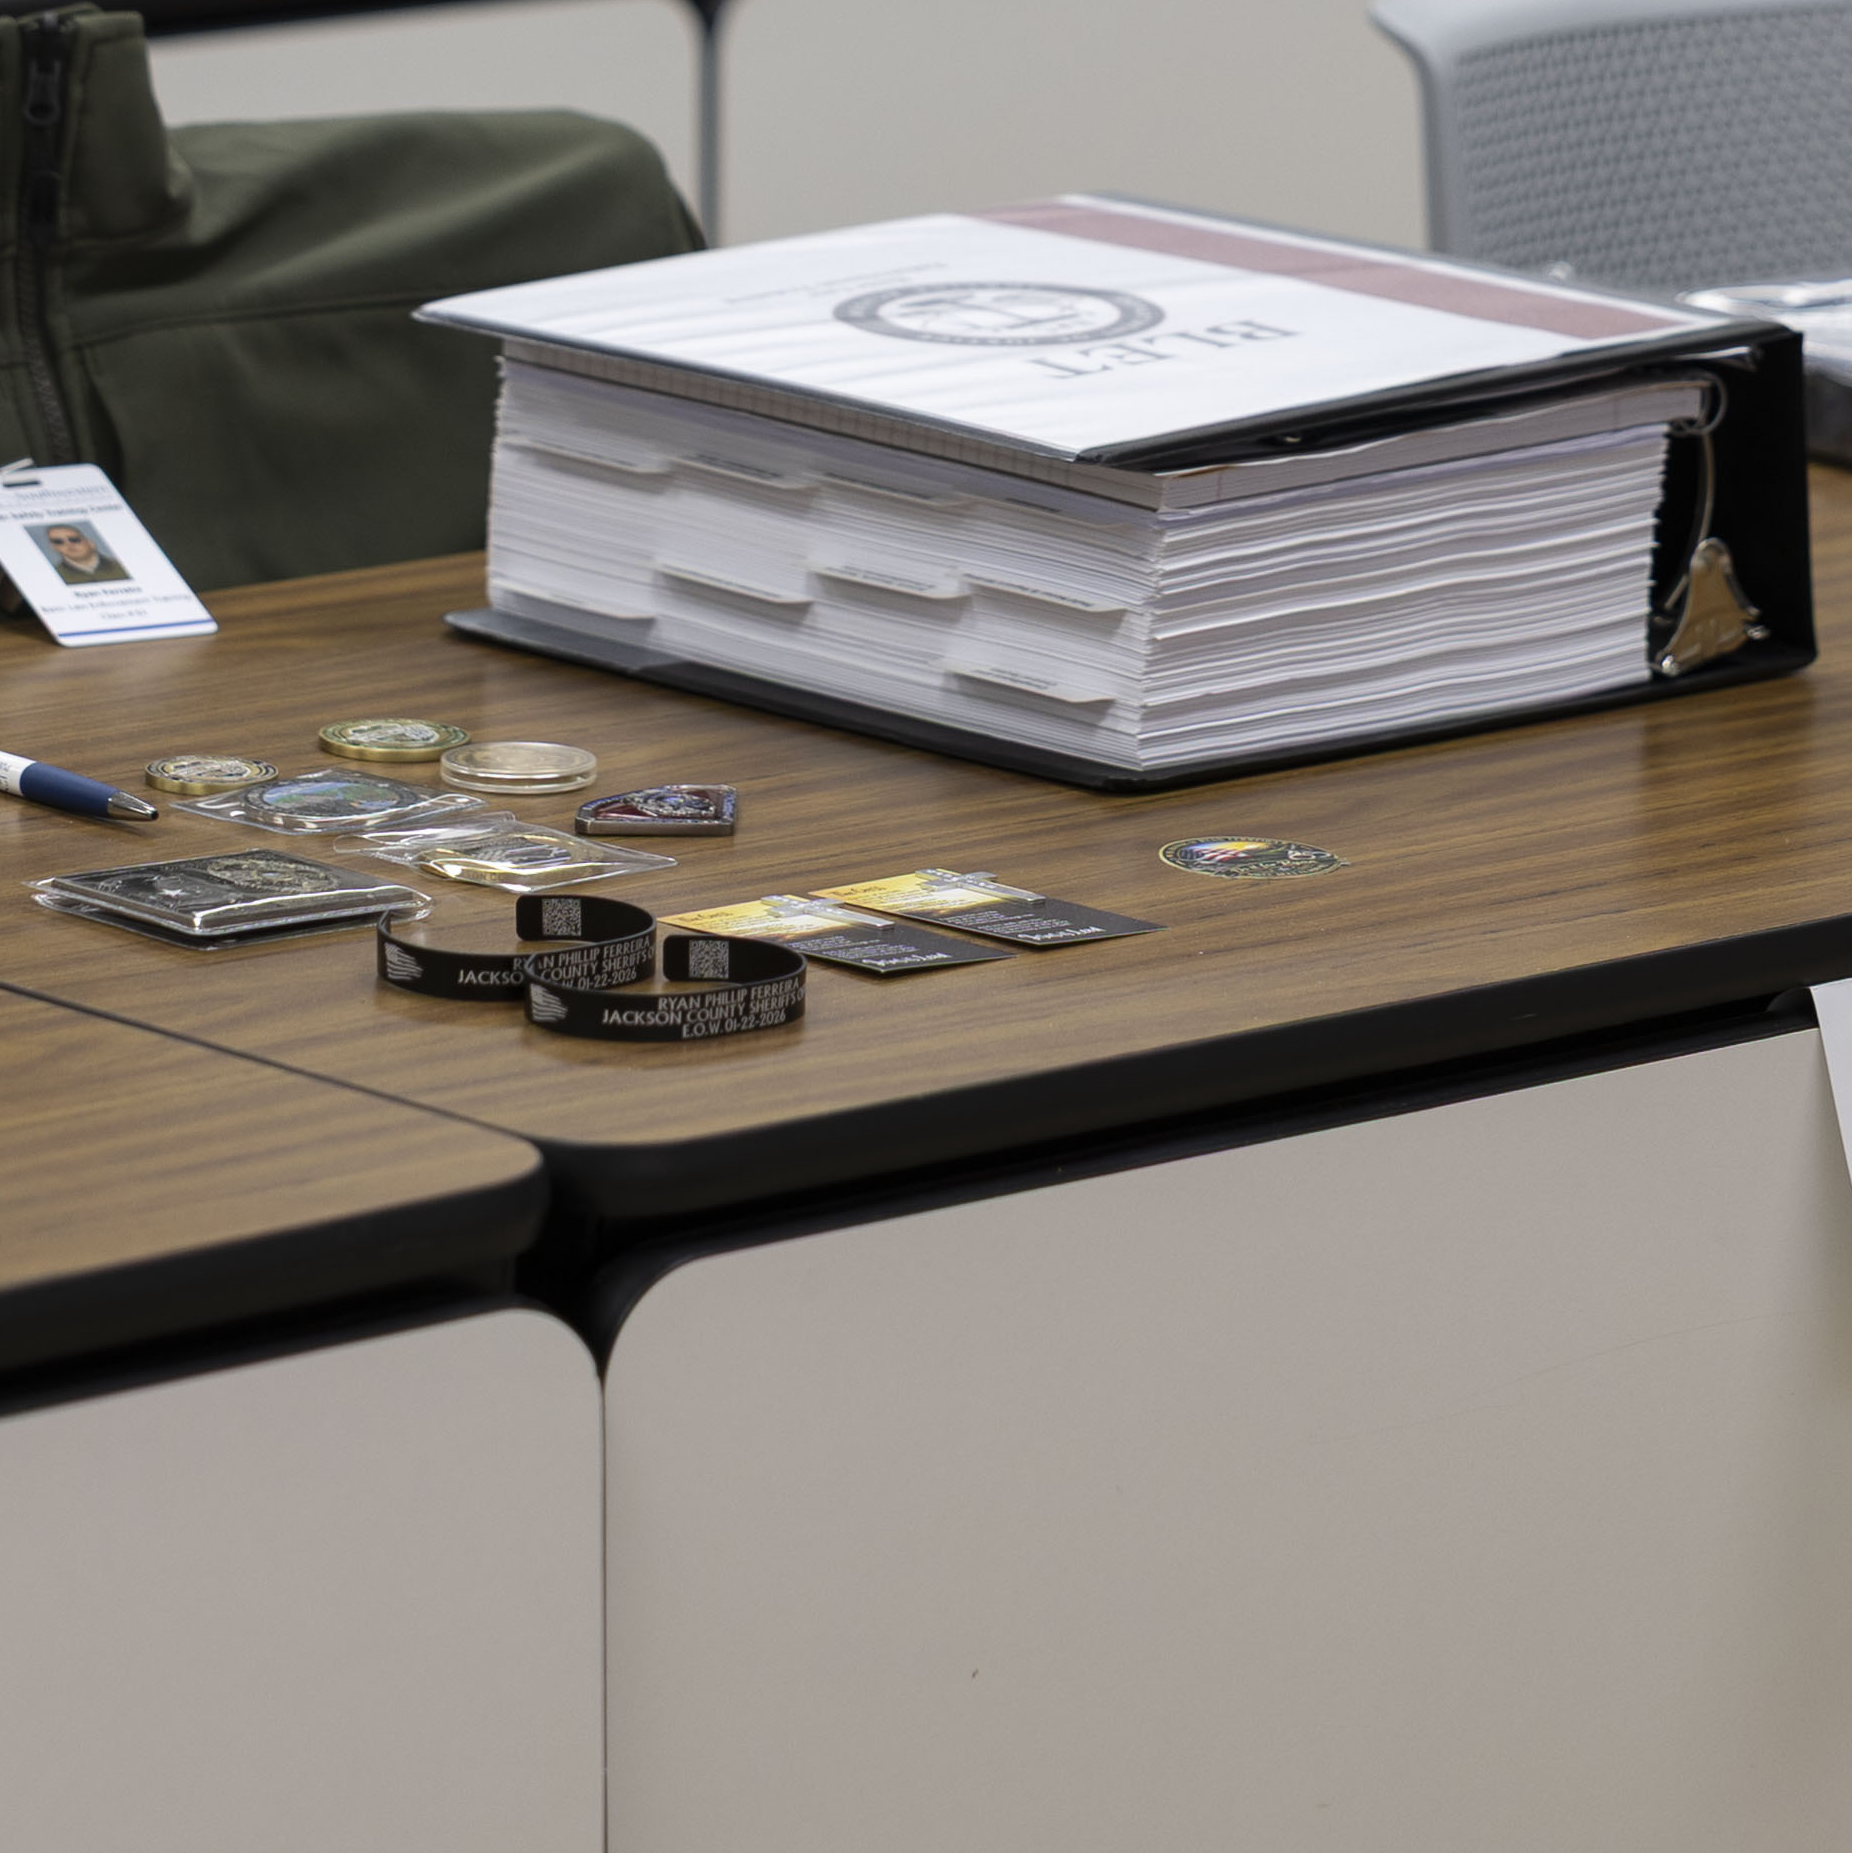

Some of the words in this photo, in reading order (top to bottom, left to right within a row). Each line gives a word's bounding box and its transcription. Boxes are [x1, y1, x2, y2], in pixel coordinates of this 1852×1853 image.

[1032, 318, 1302, 379] BLET
[558, 948, 600, 967] PHILLIP
[603, 936, 650, 959] FERREIRA
[457, 968, 525, 987] JACKSO
[541, 962, 599, 981] COUNTY
[658, 995, 701, 1011] RYAN
[704, 987, 748, 1008] PHILLIP
[751, 977, 799, 999] FERREIRA
[601, 1009, 683, 1025] JACKSON
[685, 1001, 746, 1023] COUNTY
[682, 1022, 724, 1039] E.O.W.
[725, 1010, 787, 1033] 01-22-2026
